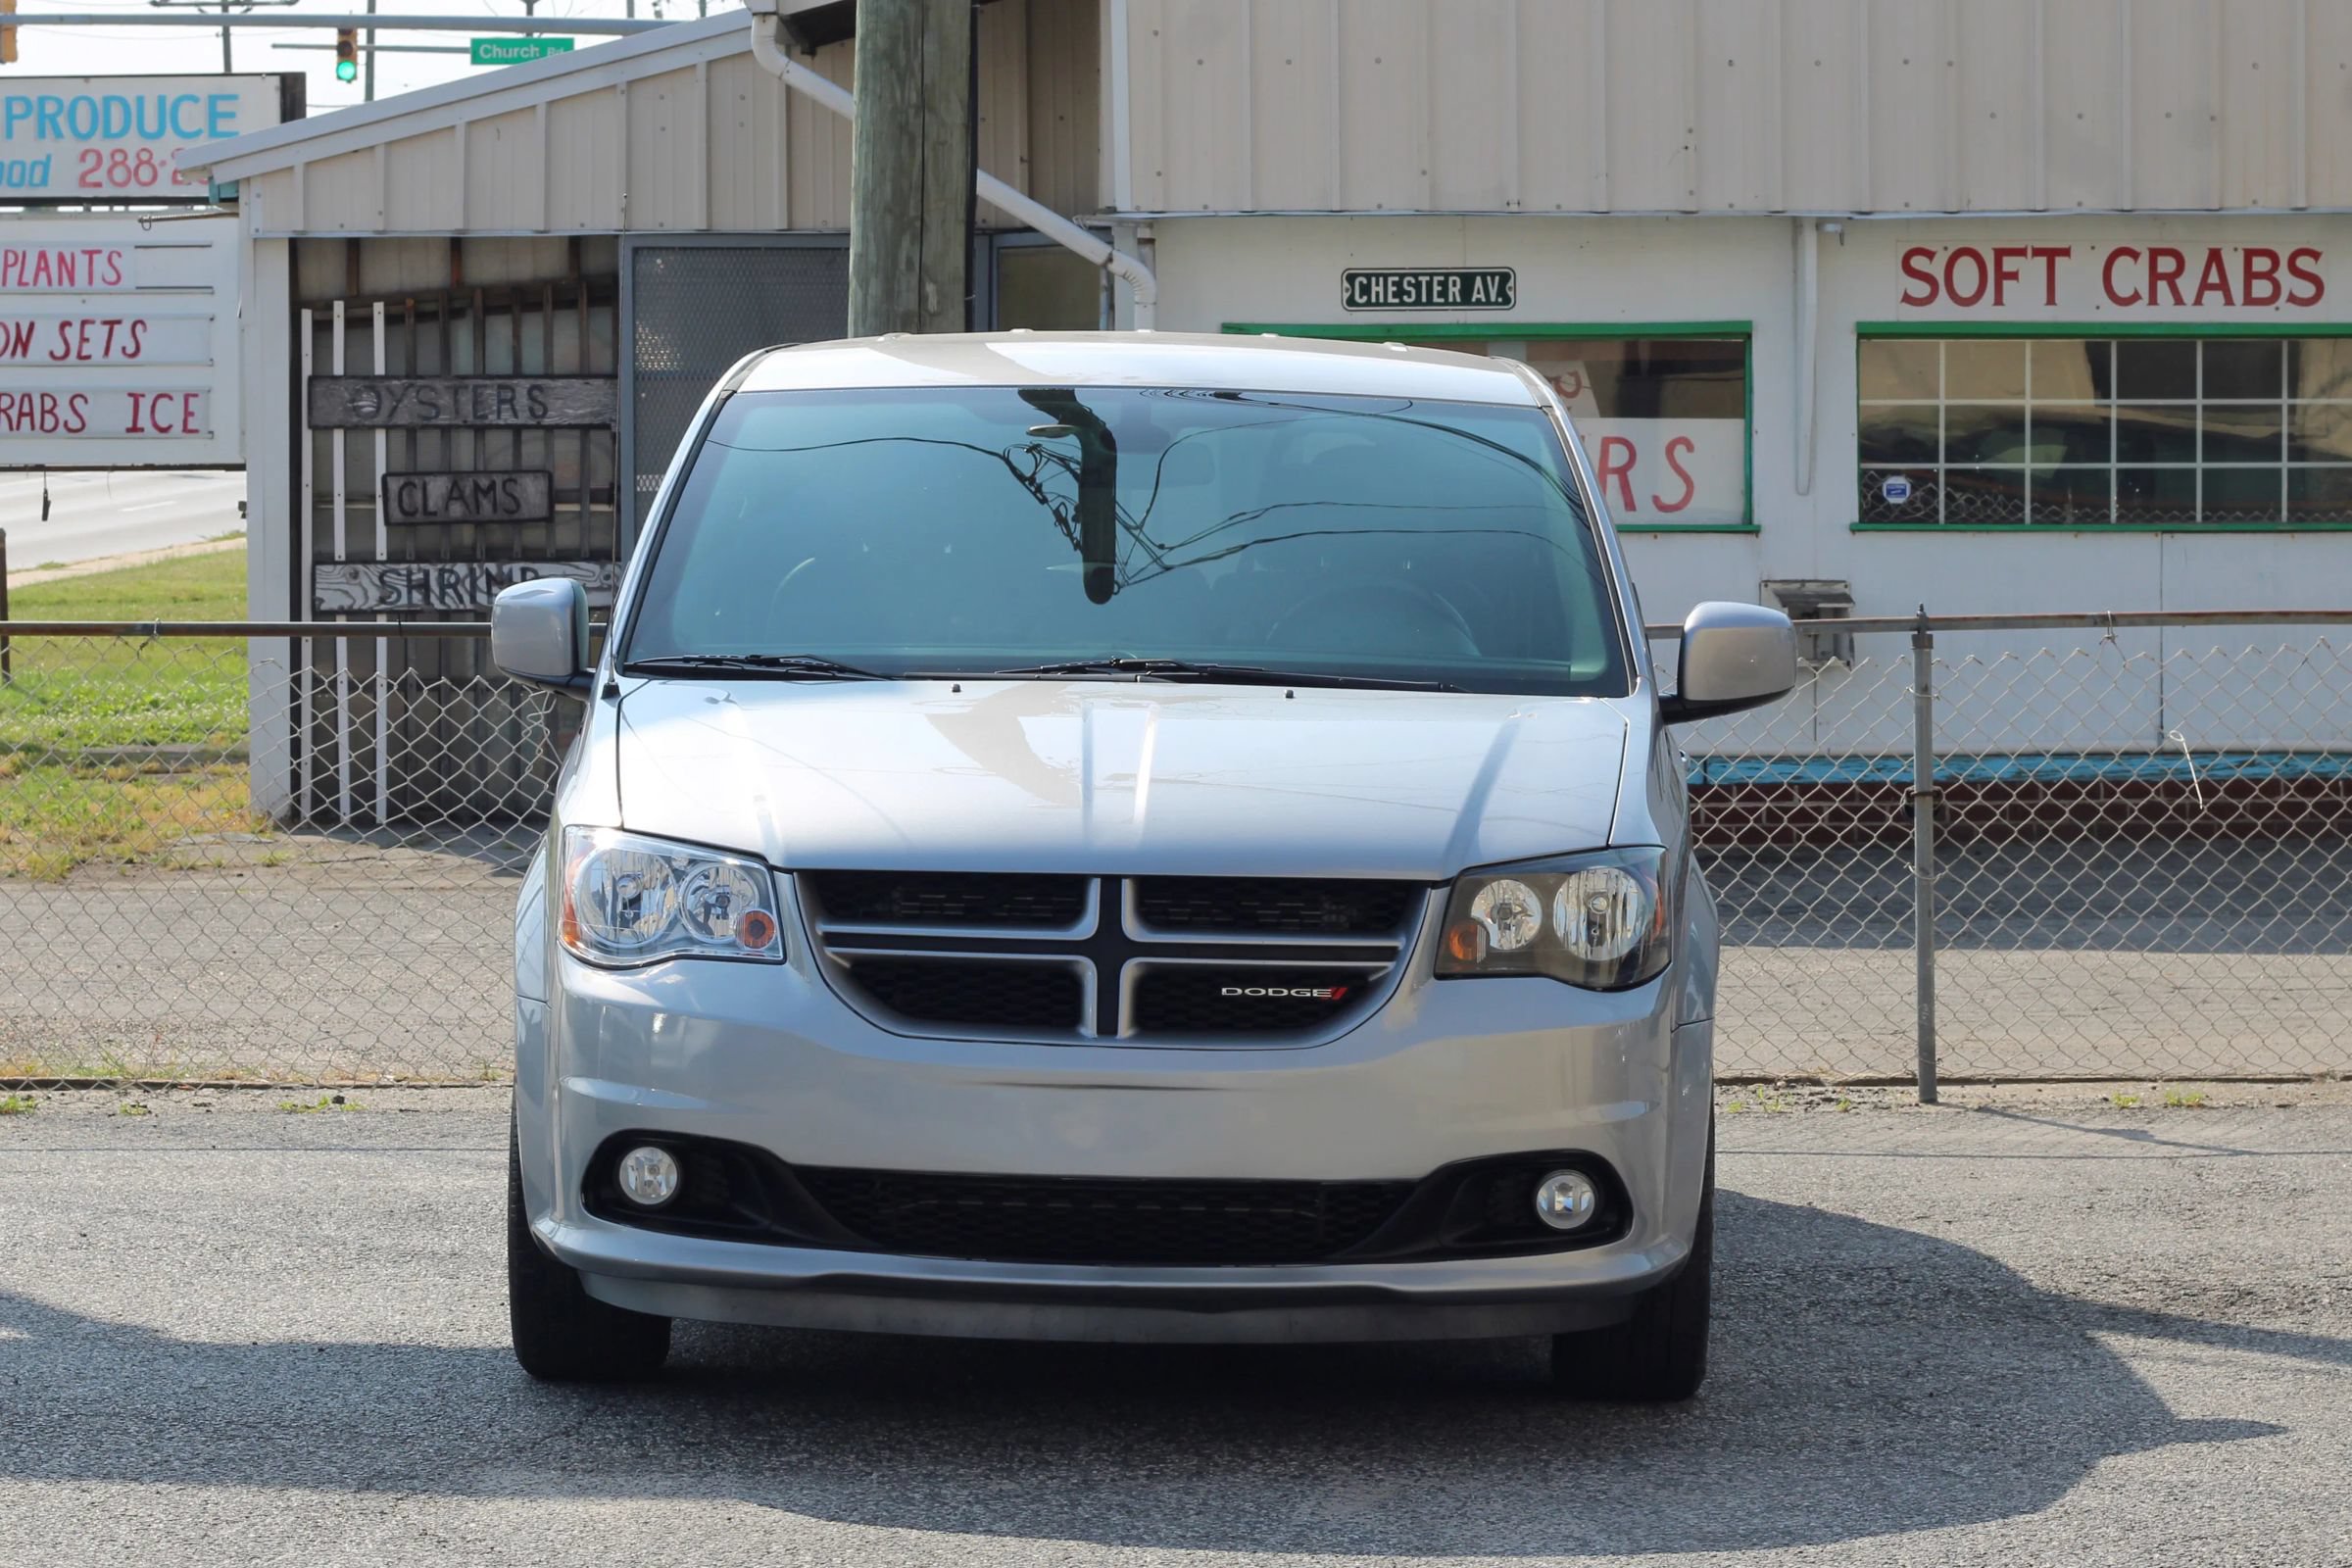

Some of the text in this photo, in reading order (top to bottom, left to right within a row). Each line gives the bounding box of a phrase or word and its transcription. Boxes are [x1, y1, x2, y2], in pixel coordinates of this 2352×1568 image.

[478, 44, 540, 59] Church
[4, 93, 240, 140] PRODUCE
[0, 152, 52, 188] od
[1, 249, 122, 287] PLANTS
[1899, 245, 2326, 308] SOFT CRABS
[1353, 274, 1503, 304] CHESTER AV.
[49, 318, 147, 361] SETS
[0, 392, 200, 433] RABS ICE
[352, 383, 549, 422] OYSTERS
[1581, 435, 1695, 514] RS
[397, 477, 522, 517] CLAMS
[1221, 987, 1333, 998] DODGE
